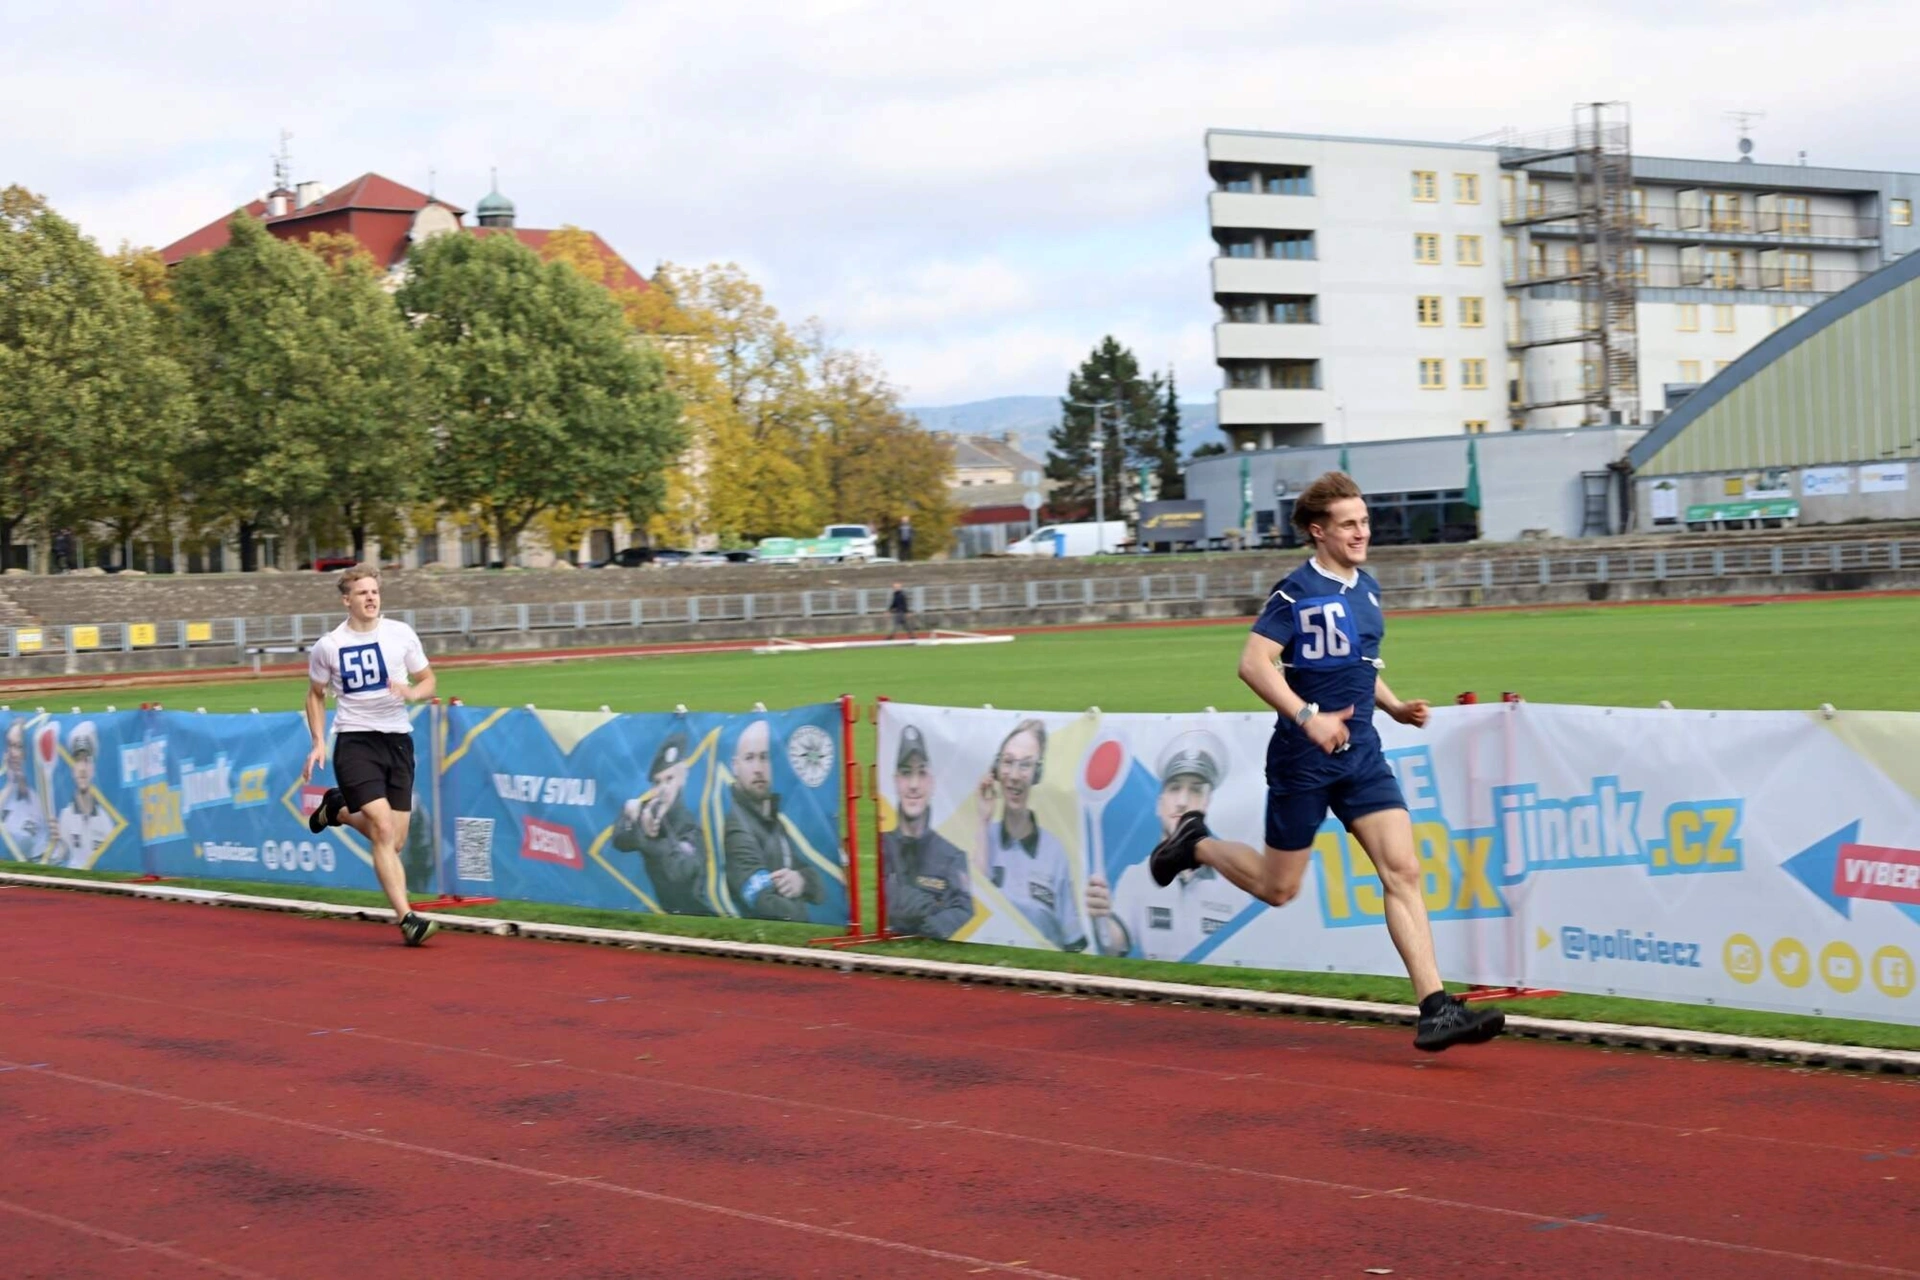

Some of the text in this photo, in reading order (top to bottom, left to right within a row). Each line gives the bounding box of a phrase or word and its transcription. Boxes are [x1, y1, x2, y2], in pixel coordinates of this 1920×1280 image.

[1299, 602, 1352, 660] 56
[343, 648, 381, 690] 59
[1844, 858, 1920, 890] VYBER
[1560, 926, 1703, 969] @policiecz
